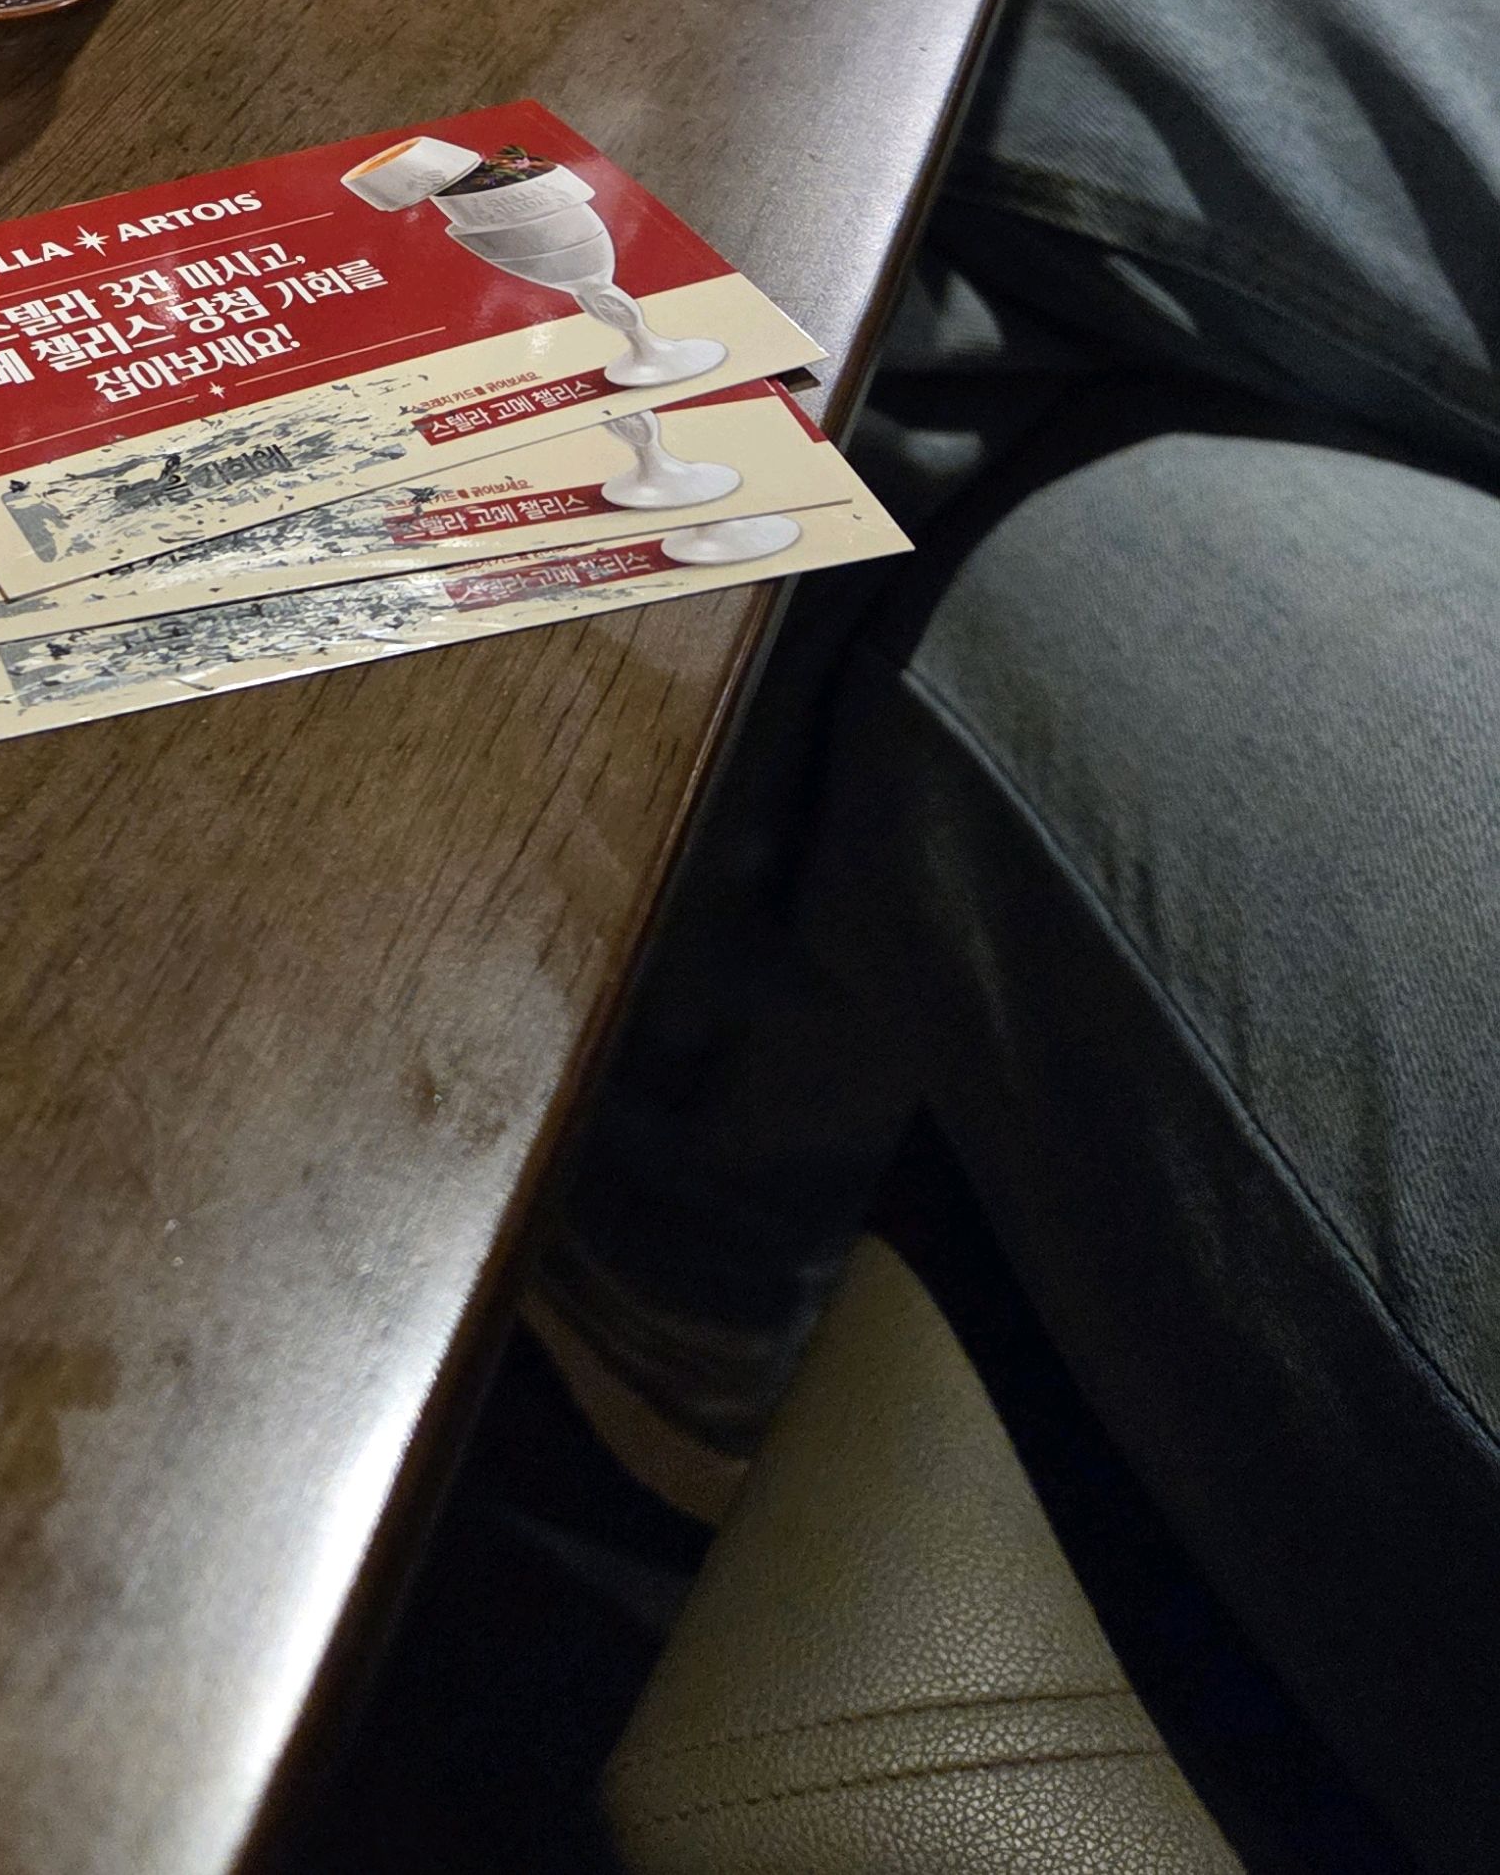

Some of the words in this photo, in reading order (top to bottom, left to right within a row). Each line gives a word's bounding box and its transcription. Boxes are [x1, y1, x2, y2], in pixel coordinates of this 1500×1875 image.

[117, 191, 263, 242] ARTOIS
[99, 268, 179, 309] 3잔
[174, 242, 306, 291] 마시고,
[30, 313, 176, 373] 챌리스
[169, 287, 270, 334] 당첨
[264, 259, 388, 309] 기회를
[87, 323, 301, 404] 잡아보세요!
[430, 408, 492, 439] 스텔라
[489, 395, 536, 421] 고메
[531, 379, 599, 403] 챌리스
[468, 503, 519, 528] 고메
[518, 494, 590, 521] 챌리스
